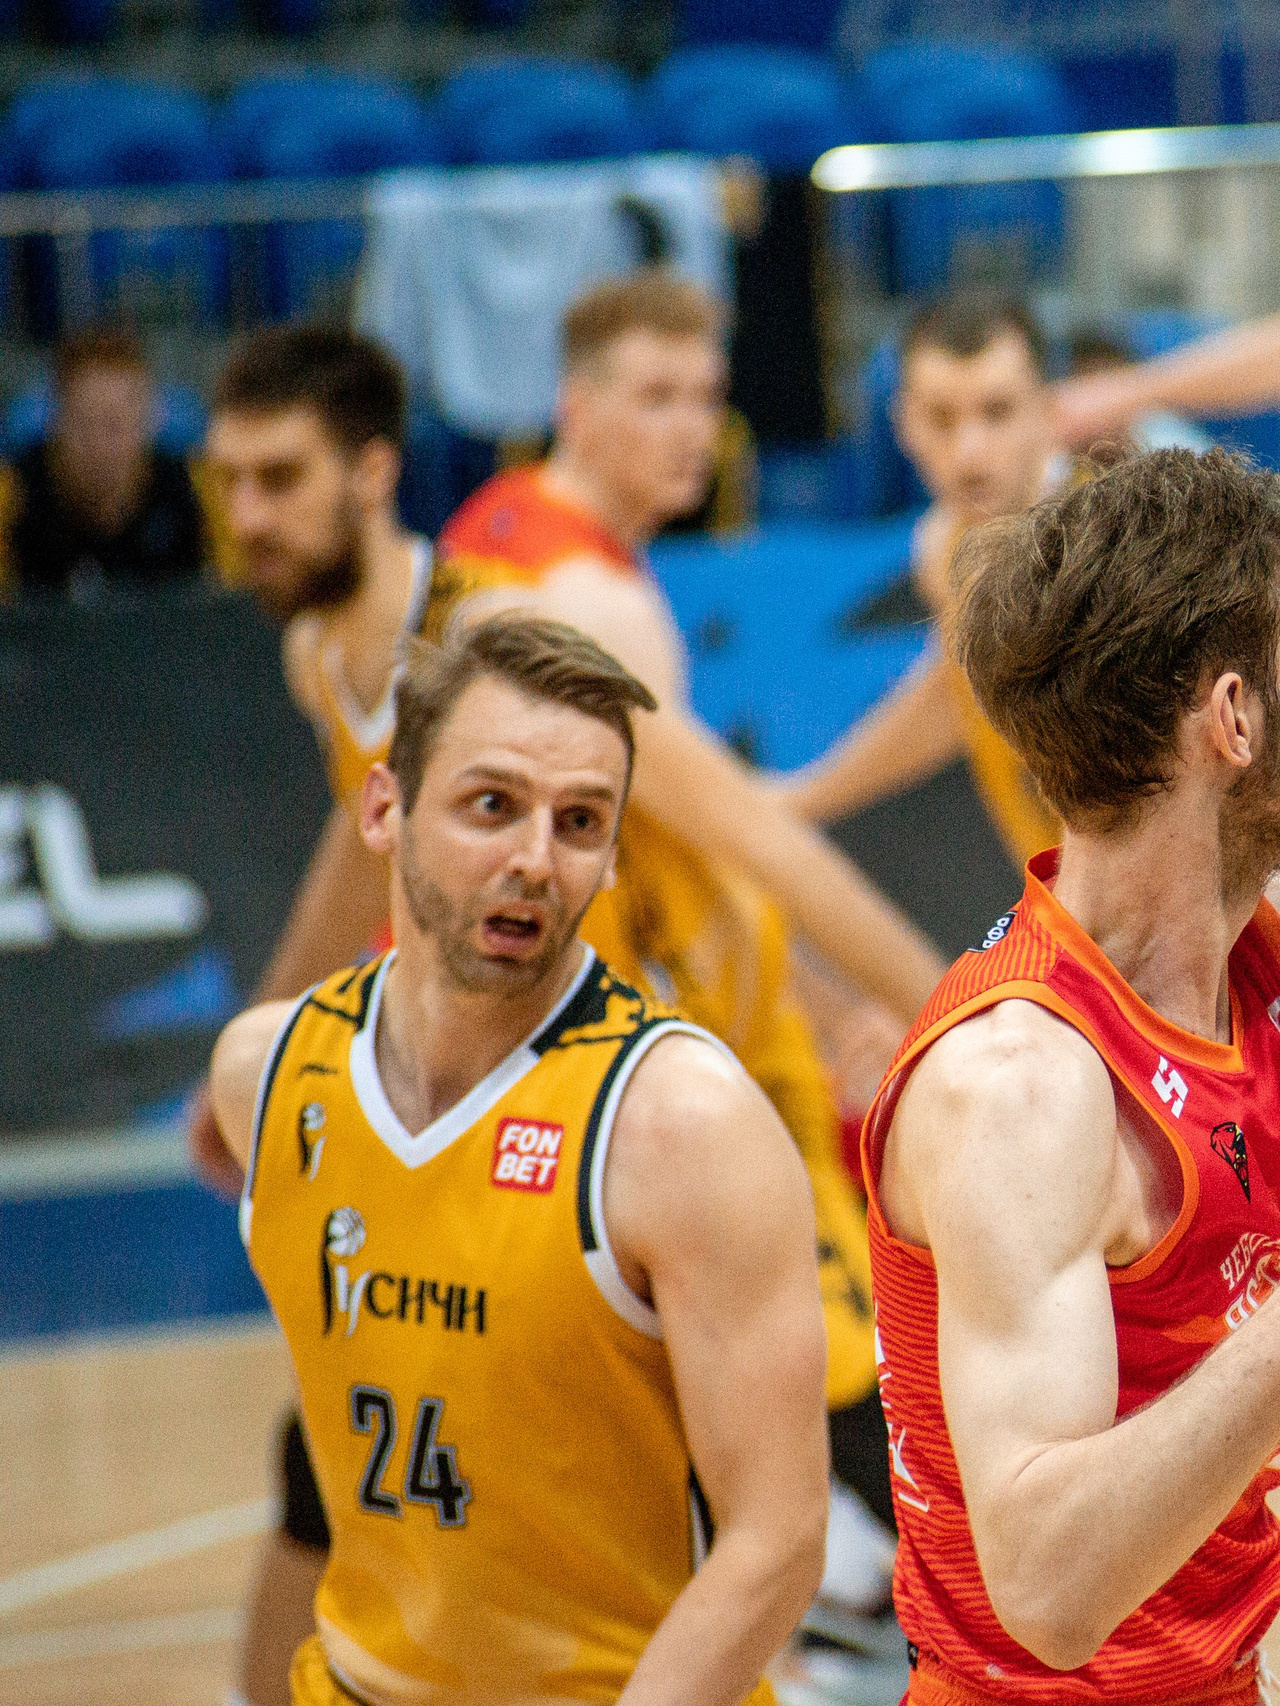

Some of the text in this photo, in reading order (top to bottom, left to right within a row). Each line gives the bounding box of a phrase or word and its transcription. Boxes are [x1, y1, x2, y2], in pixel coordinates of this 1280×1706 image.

[500, 1124, 563, 1155] FON
[495, 1152, 558, 1186] BET
[350, 1383, 472, 1528] 24
